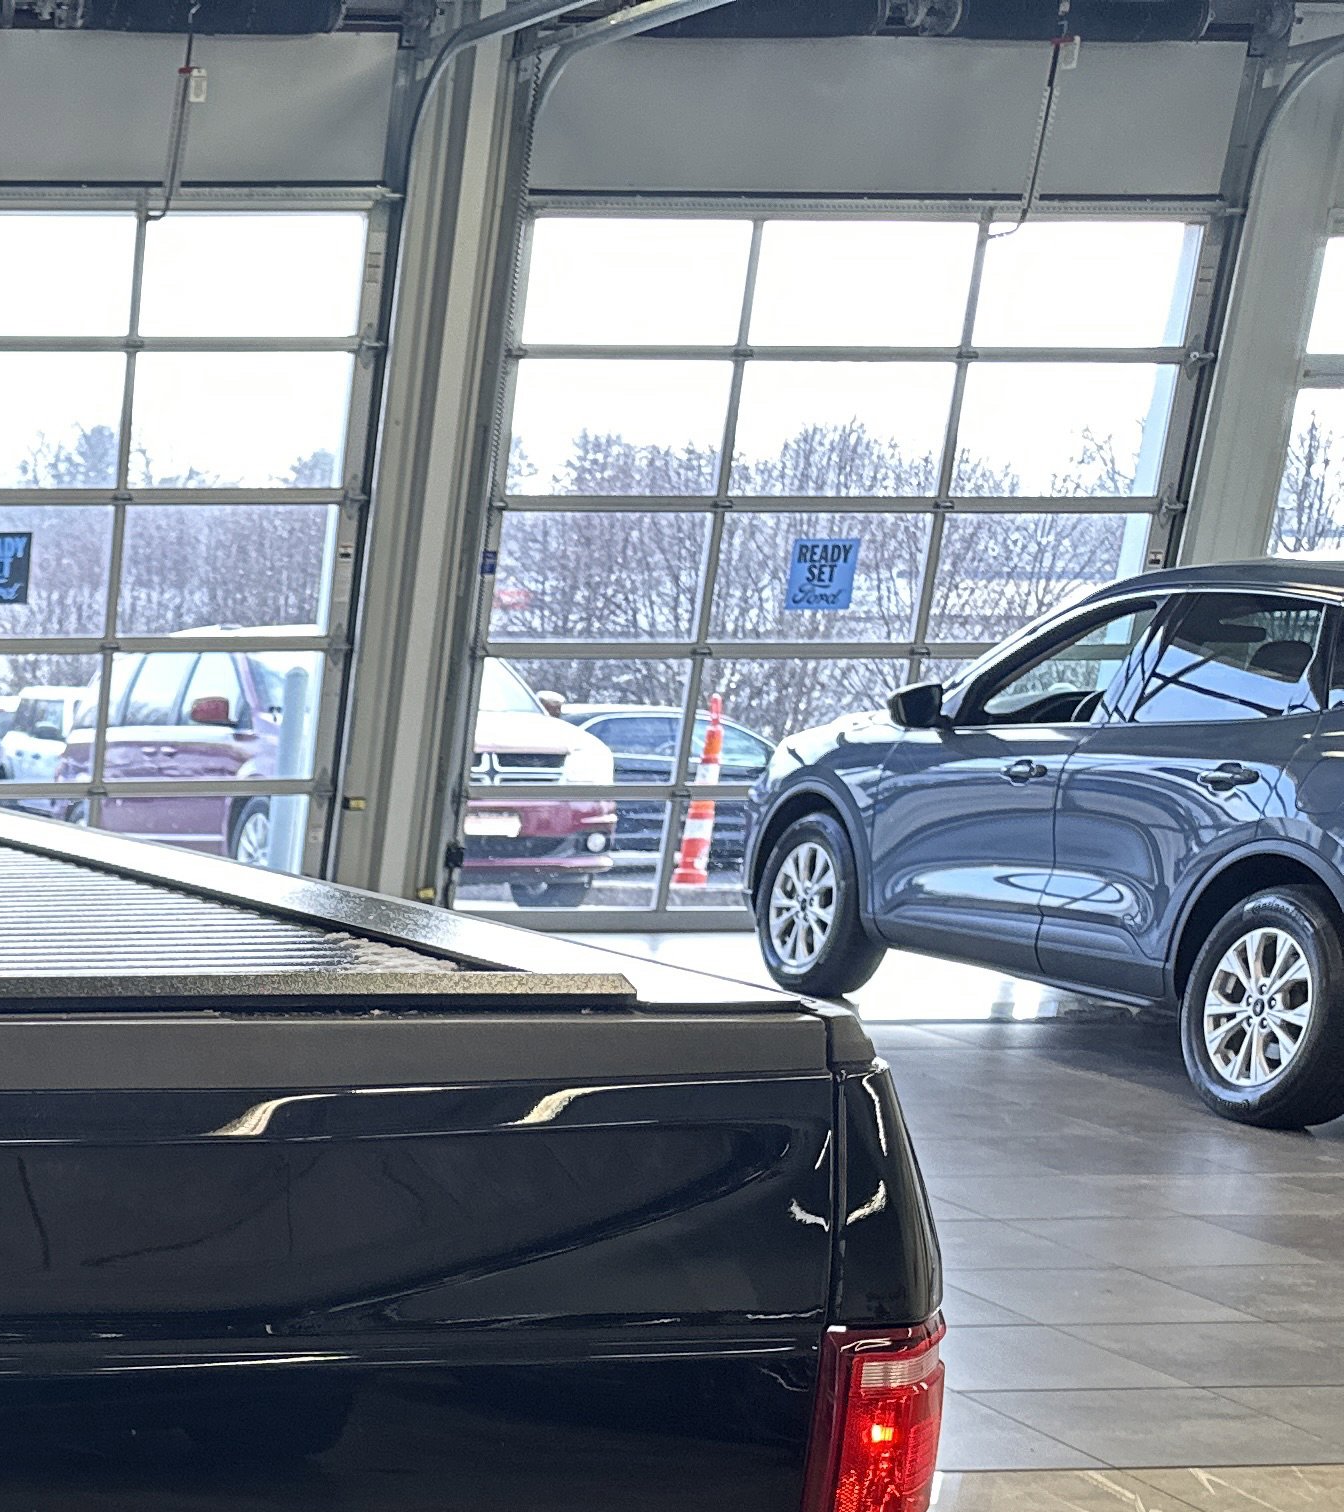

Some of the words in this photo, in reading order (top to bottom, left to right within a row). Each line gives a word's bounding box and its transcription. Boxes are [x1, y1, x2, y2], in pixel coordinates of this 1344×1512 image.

[797, 544, 852, 563] READY
[806, 564, 837, 583] SET
[792, 582, 843, 605] Ford
